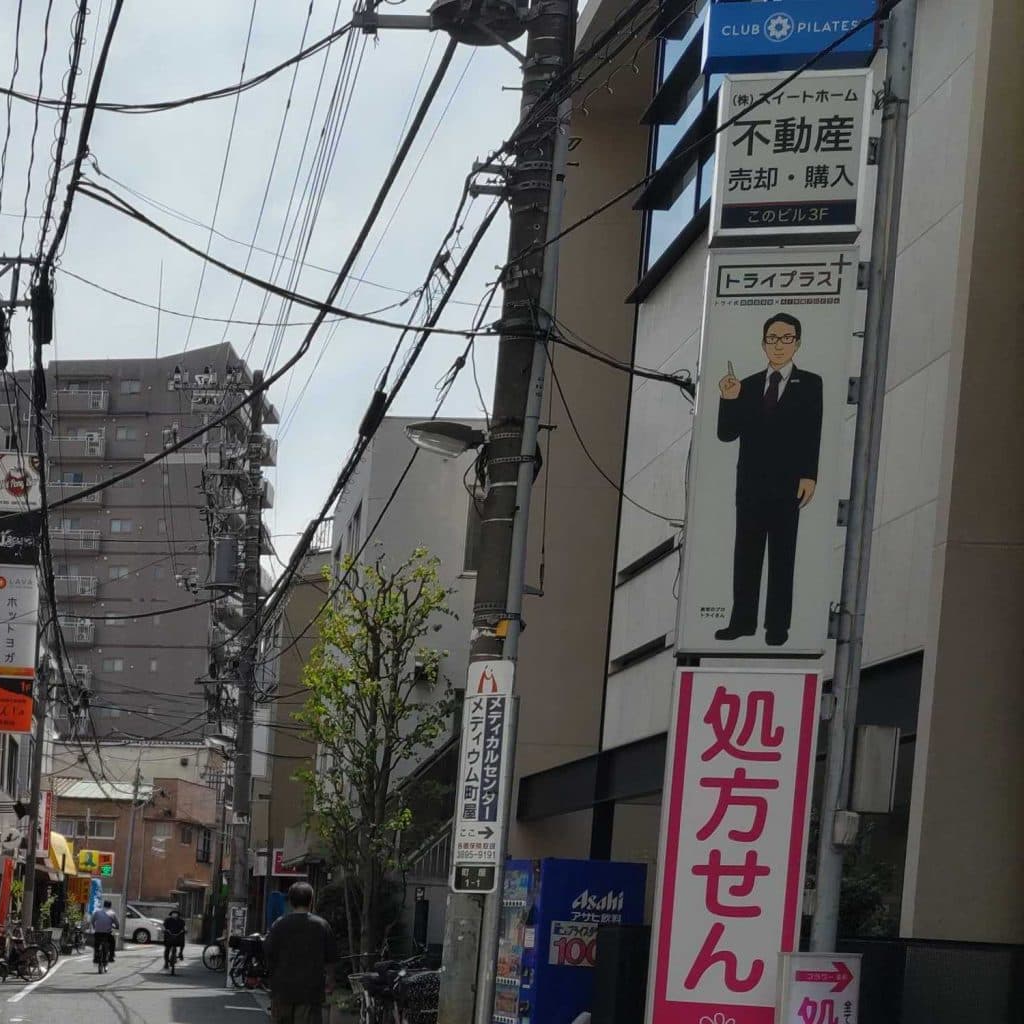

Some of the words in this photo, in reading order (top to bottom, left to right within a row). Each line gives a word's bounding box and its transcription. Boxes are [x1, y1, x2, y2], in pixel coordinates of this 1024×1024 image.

[721, 22, 760, 36] CLUB
[796, 19, 859, 33] PILATES
[732, 114, 854, 156] 不動産
[728, 164, 854, 192] 売却・購入
[747, 206, 829, 224] このビル3F
[5, 596, 19, 664] ホットヨガ
[481, 697, 502, 820] メディカルセンター
[682, 684, 785, 993] 処方せん
[572, 888, 625, 911] Asahi
